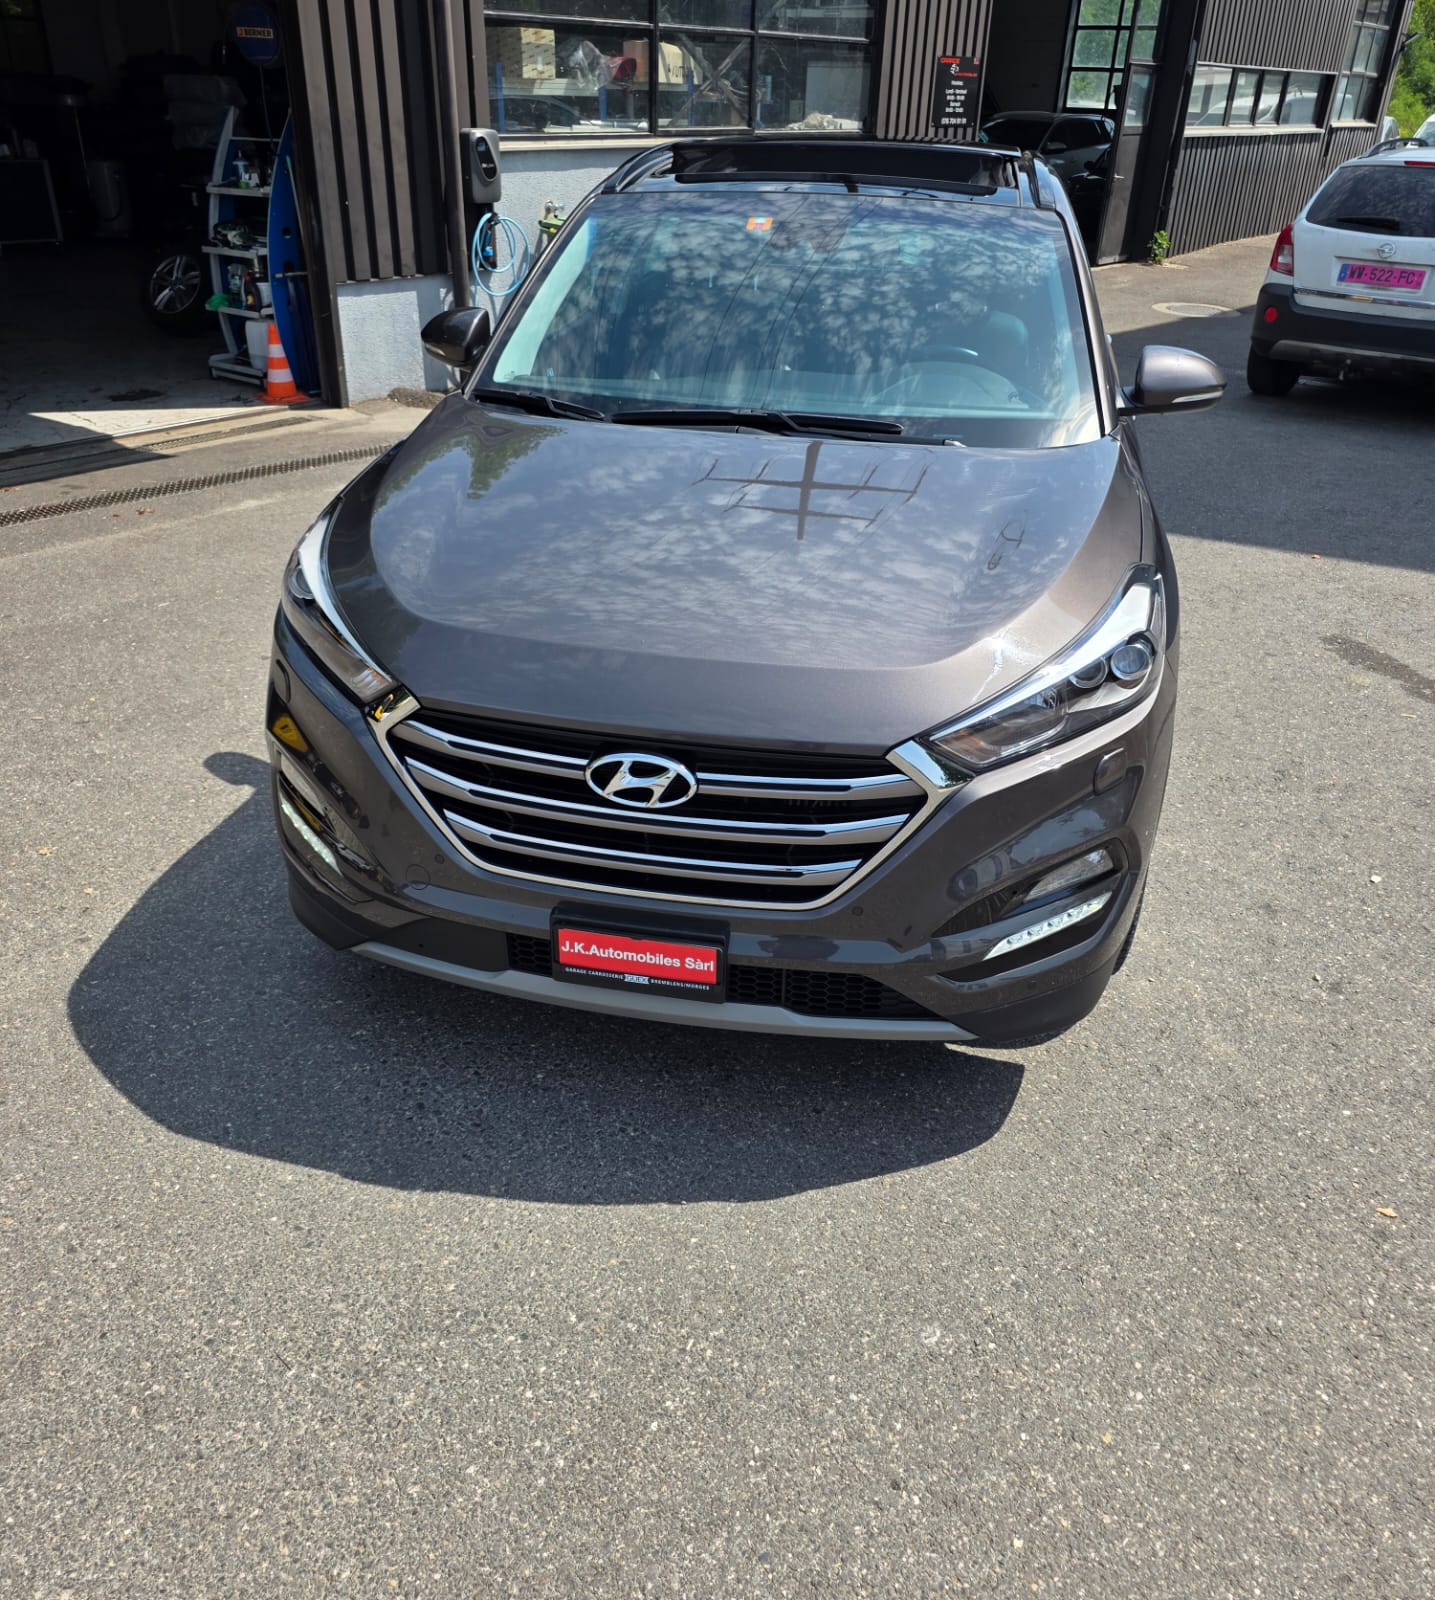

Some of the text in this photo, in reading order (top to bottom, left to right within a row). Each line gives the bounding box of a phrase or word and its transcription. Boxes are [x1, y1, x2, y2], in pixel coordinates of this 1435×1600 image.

[560, 940, 681, 968] J.K.Automobiles
[565, 967, 587, 975] GARAGE
[588, 971, 624, 980] CARROSSERIE
